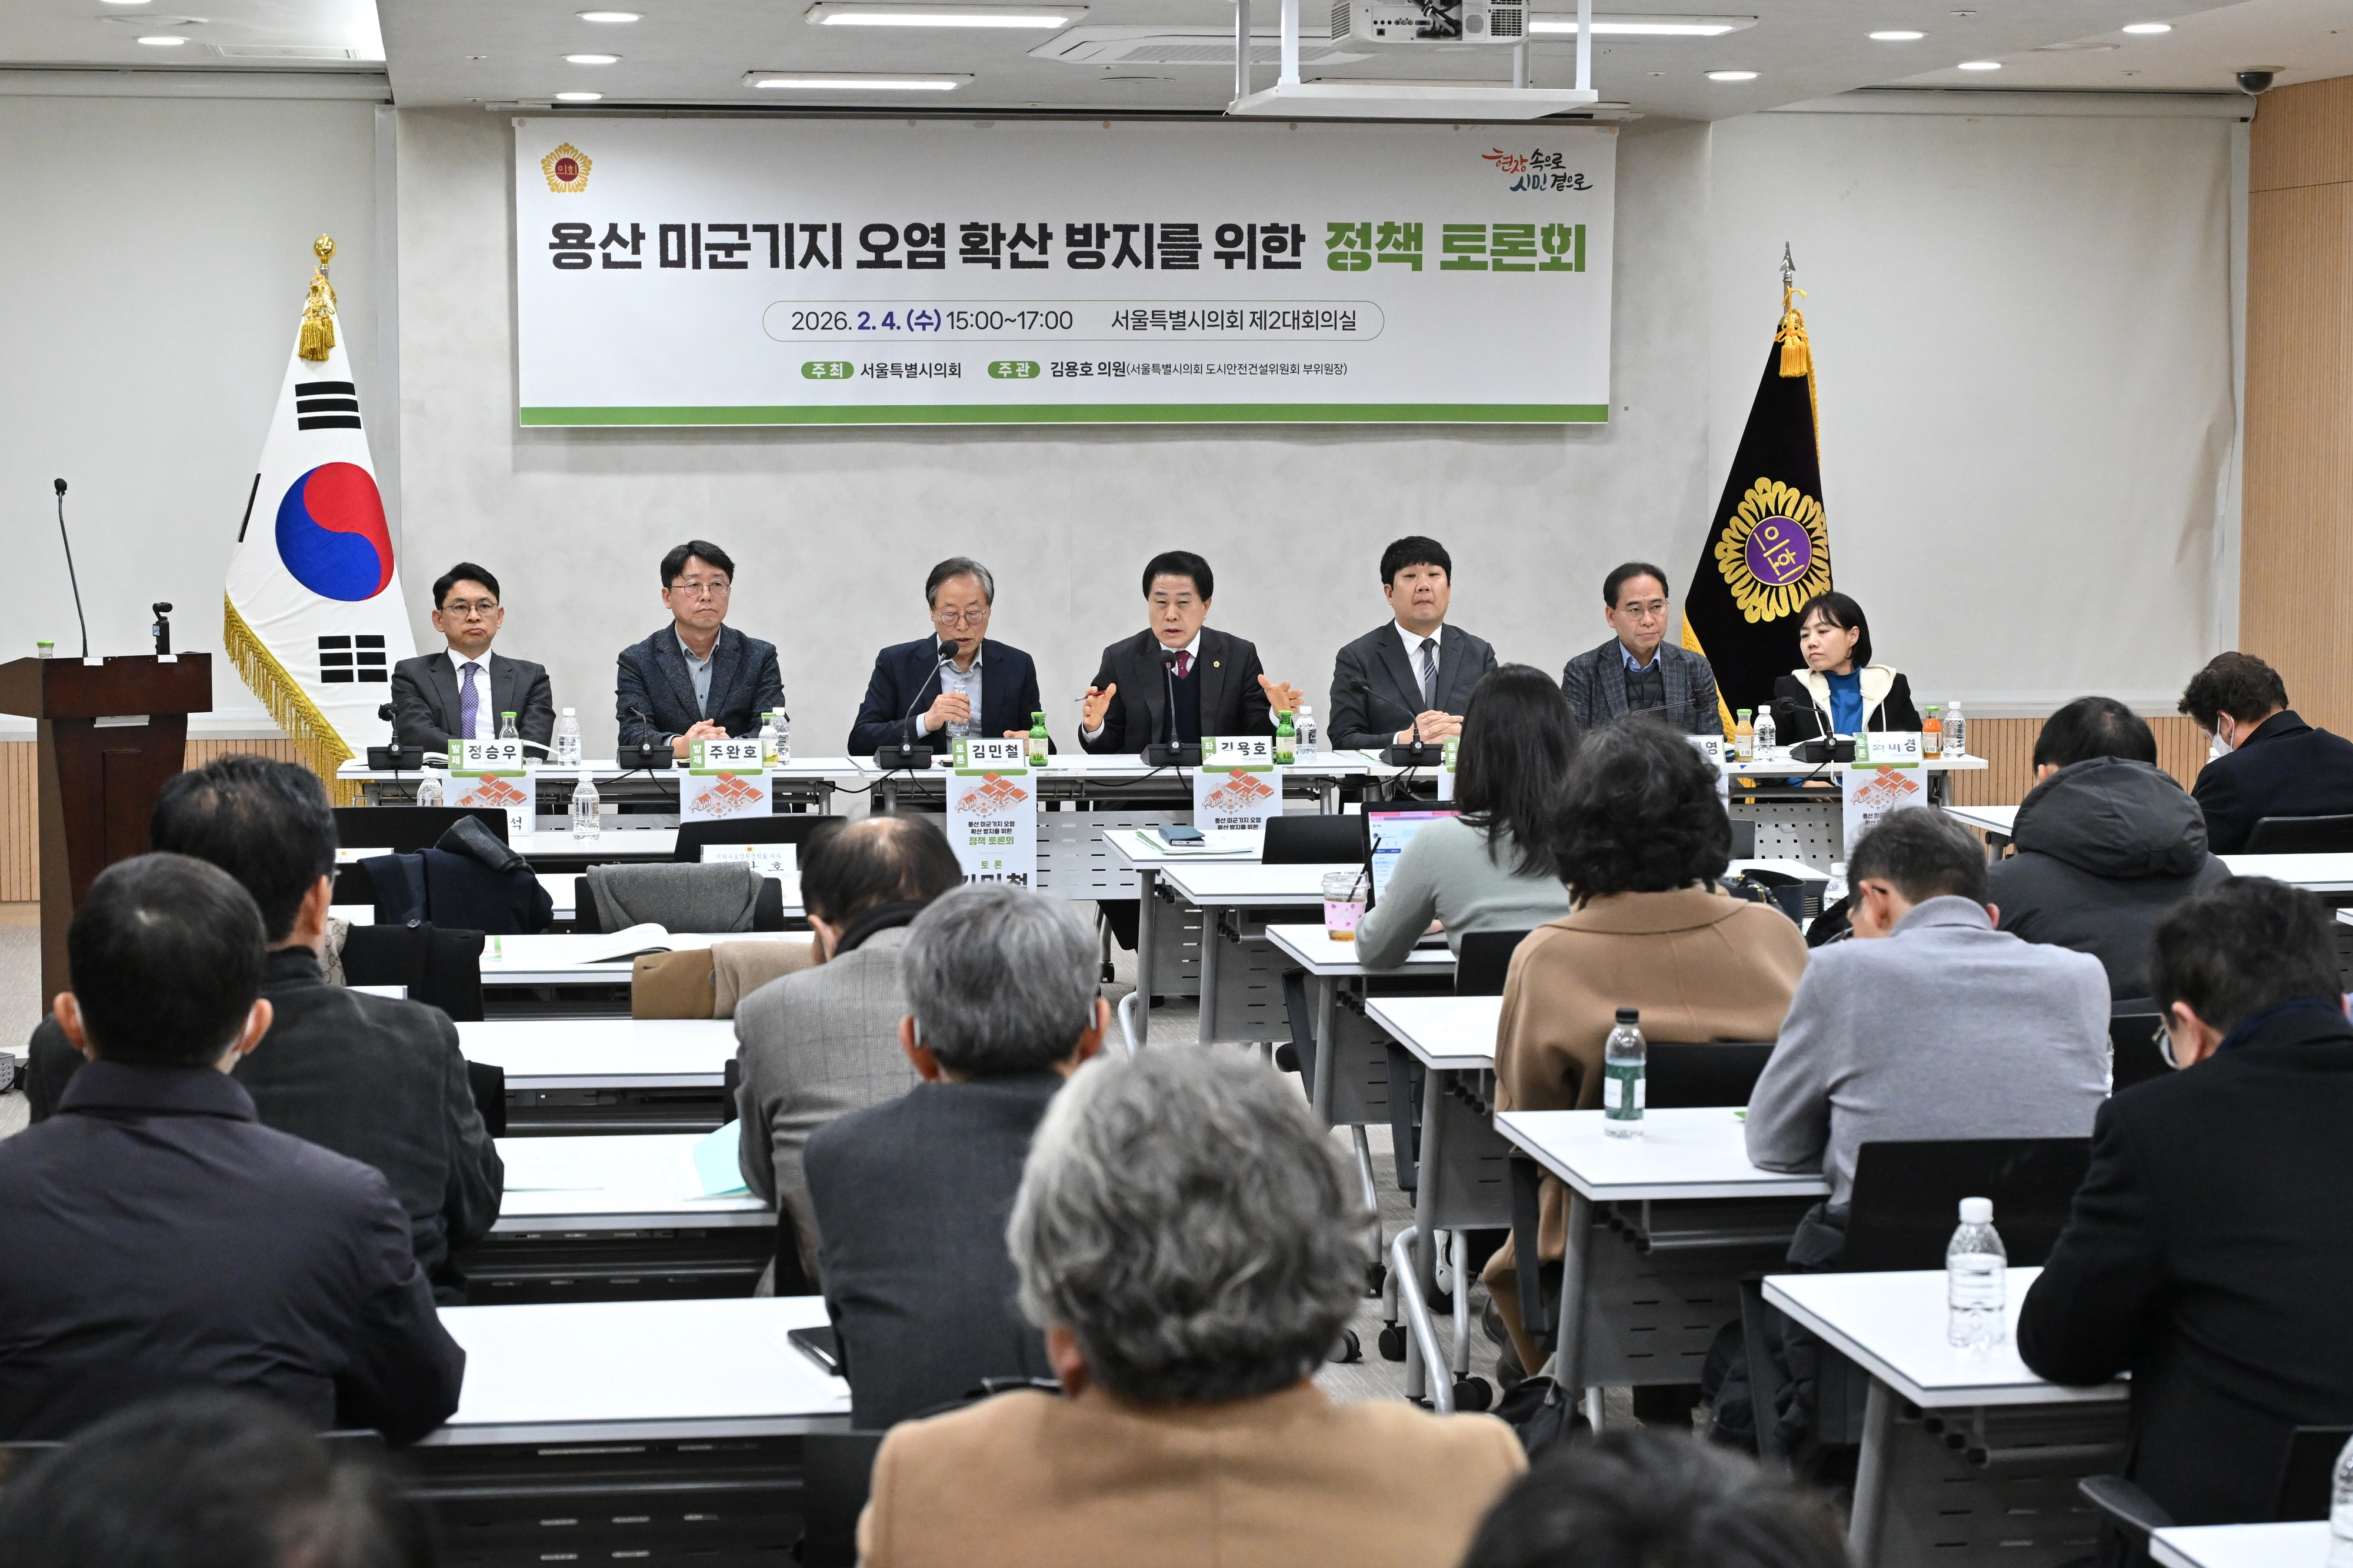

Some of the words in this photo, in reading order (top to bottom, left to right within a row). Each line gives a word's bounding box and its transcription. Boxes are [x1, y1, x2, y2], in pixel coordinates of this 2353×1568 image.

[556, 164, 577, 175] 의회
[1481, 147, 1529, 174] 현장
[1529, 148, 1567, 172] 속으로
[1509, 173, 1547, 192] 시민
[1550, 172, 1594, 192] 곁으로
[548, 222, 646, 270] 용산
[659, 222, 842, 270] 미군기지
[856, 222, 946, 270] 오염
[959, 221, 1054, 270] 확산
[1065, 222, 1202, 270] 방지를
[1214, 222, 1306, 271] 위한
[1324, 221, 1424, 272] 정책
[1439, 222, 1587, 272] 토론회
[791, 311, 852, 331] 2026.
[857, 311, 876, 331] 2.
[881, 311, 901, 331] 4.
[906, 308, 941, 333] (수)
[946, 311, 1074, 330] 15:00~17:00
[1111, 309, 1244, 331] 서울특별시의회
[1249, 309, 1357, 331] 제2대회의실
[860, 362, 961, 379] 서울특별시의회
[1050, 361, 1094, 378] 김용호
[1205, 363, 1299, 375] 도시안전건설위원회
[1302, 362, 1347, 376] 부위원장)
[1754, 526, 1805, 582] 의회
[468, 745, 516, 760] 정승우
[709, 745, 757, 759] 주완호
[972, 744, 1018, 759] 김민철
[969, 836, 986, 845] 정책
[988, 836, 1014, 845] 토론회
